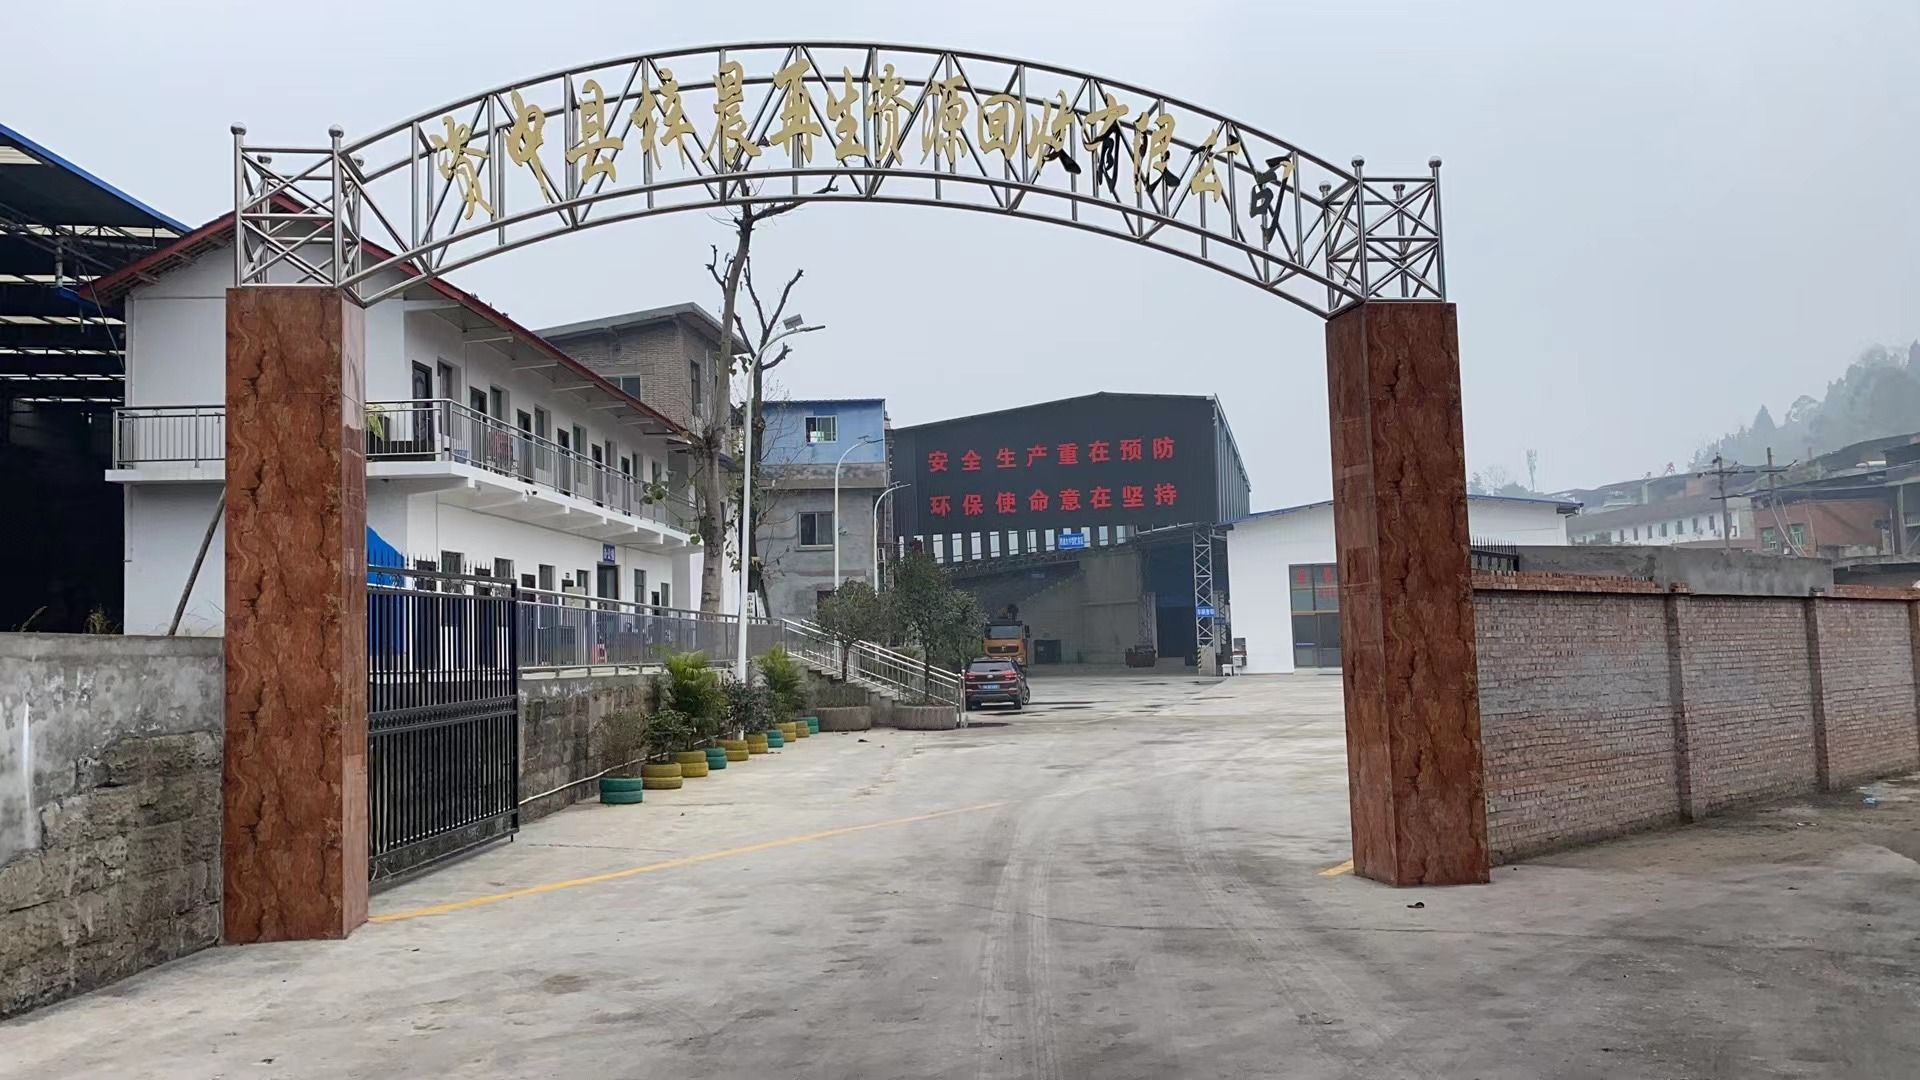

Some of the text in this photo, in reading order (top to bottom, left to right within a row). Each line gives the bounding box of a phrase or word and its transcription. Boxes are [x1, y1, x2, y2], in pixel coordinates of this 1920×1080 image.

[929, 437, 1175, 472] 安全生产重在预防
[931, 483, 1177, 516] 环保使命意在坚持
